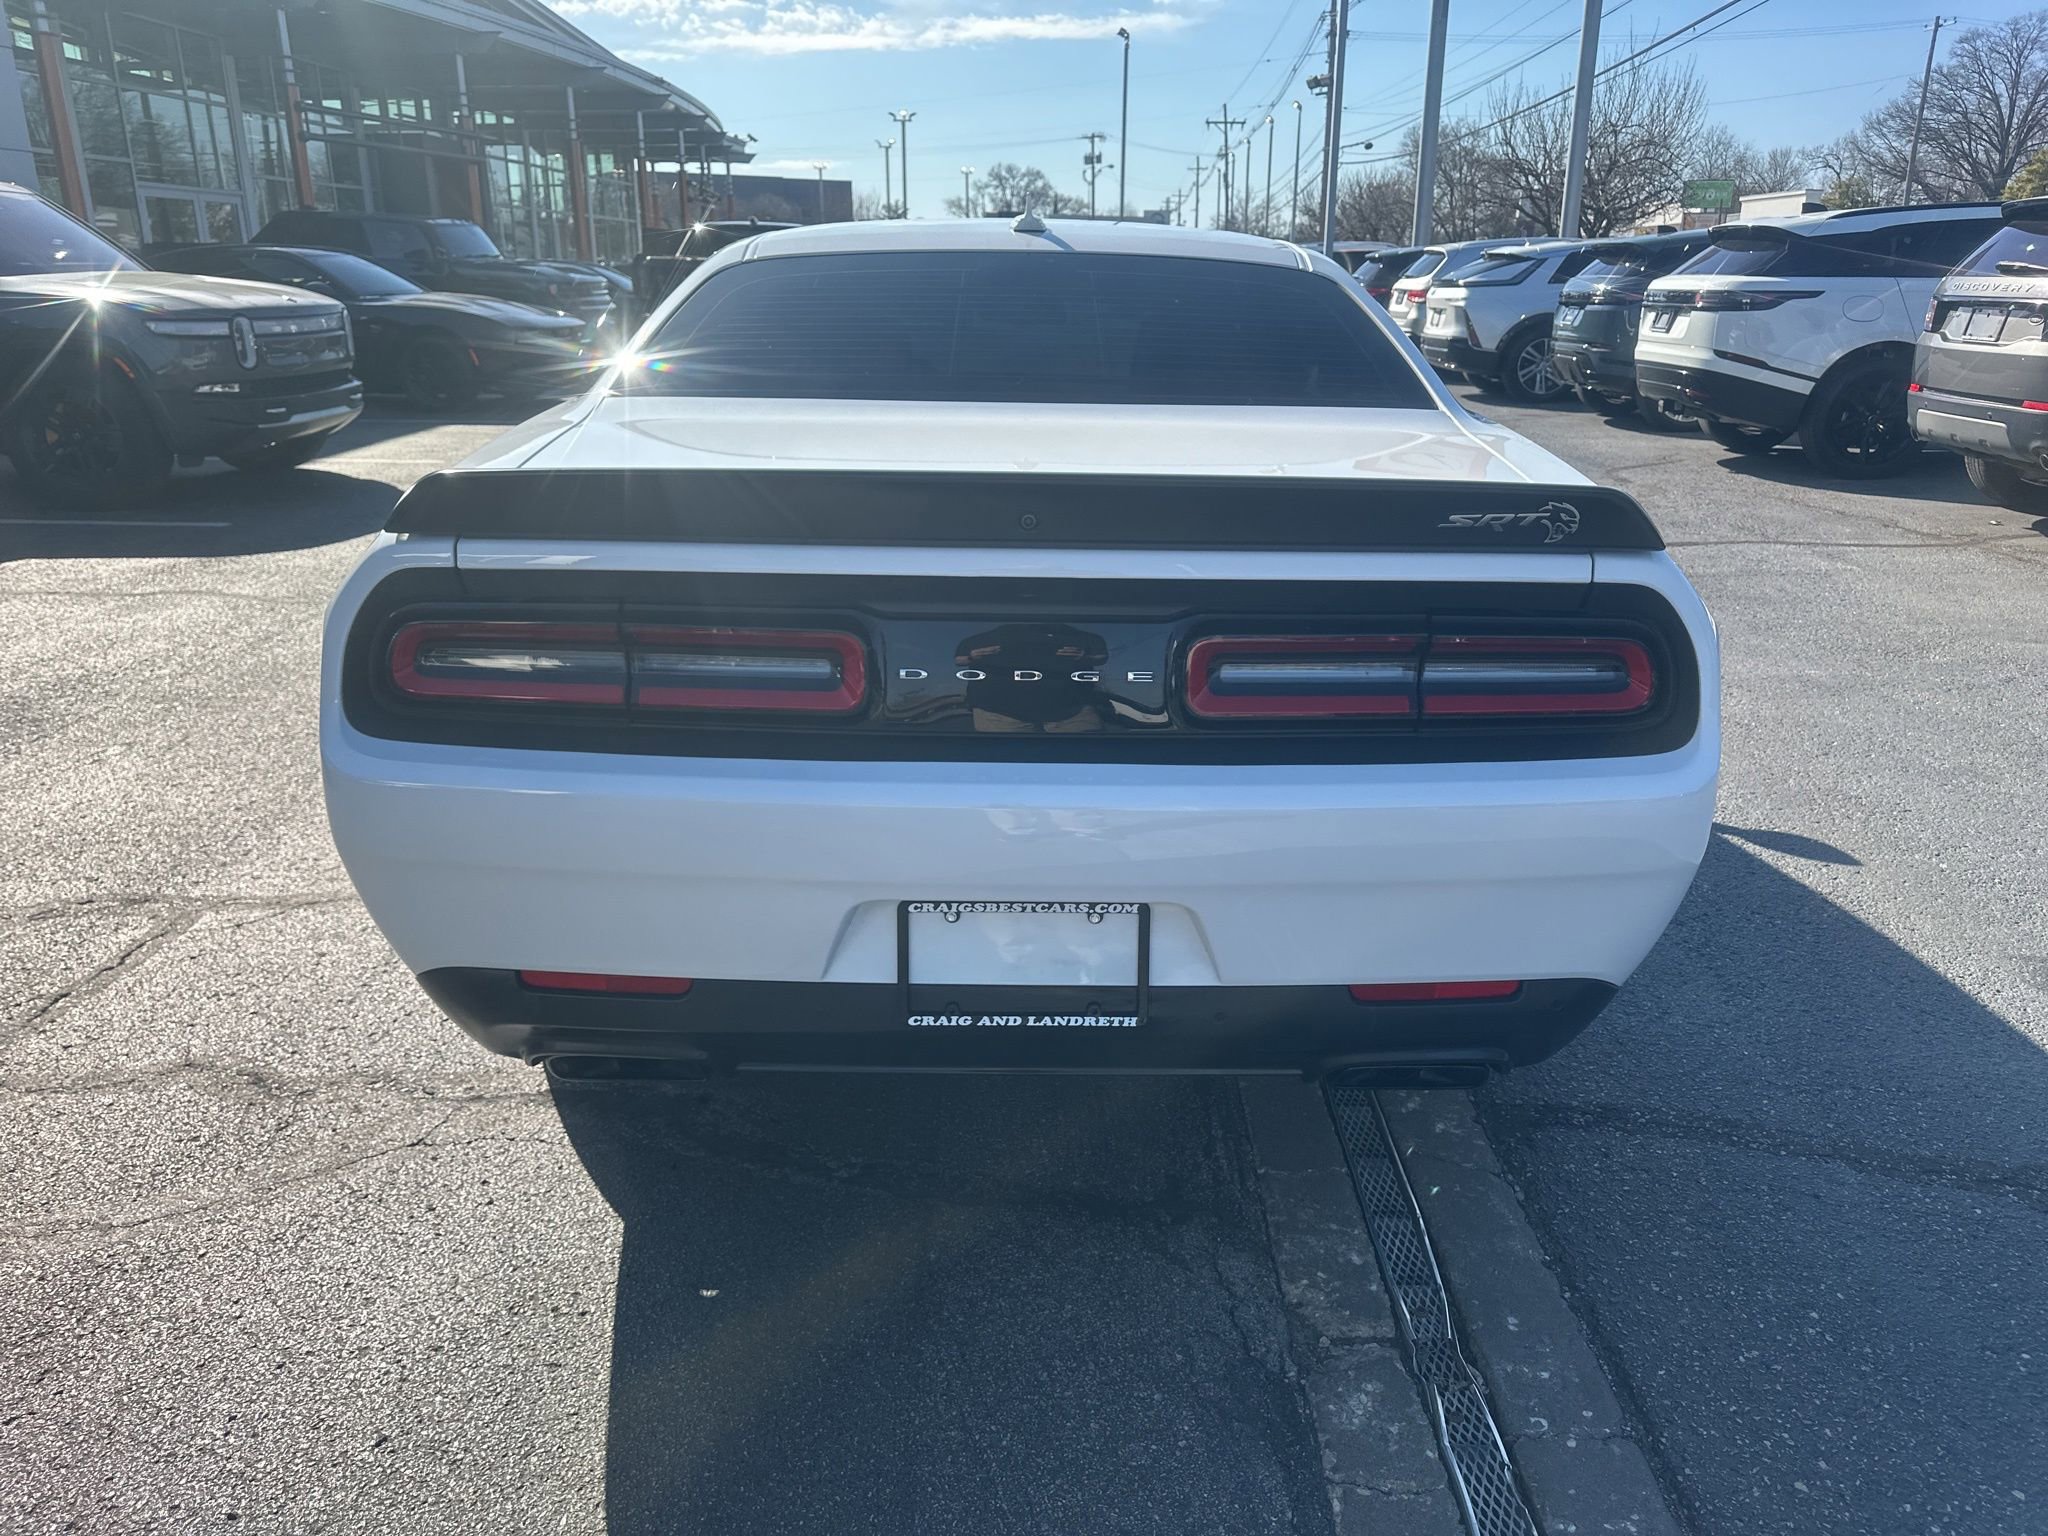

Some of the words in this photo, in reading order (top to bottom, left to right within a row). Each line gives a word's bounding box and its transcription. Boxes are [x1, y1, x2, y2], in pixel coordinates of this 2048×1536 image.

[1952, 281, 2036, 293] DISCOVERY
[1437, 512, 1551, 532] SRT
[899, 668, 1153, 682] DODGE
[908, 902, 1140, 914] CRAIGSBESTCARS.COM
[907, 1015, 973, 1027] CRAIG
[976, 1015, 1022, 1027] AND
[1026, 1015, 1138, 1027] LANDRETH
